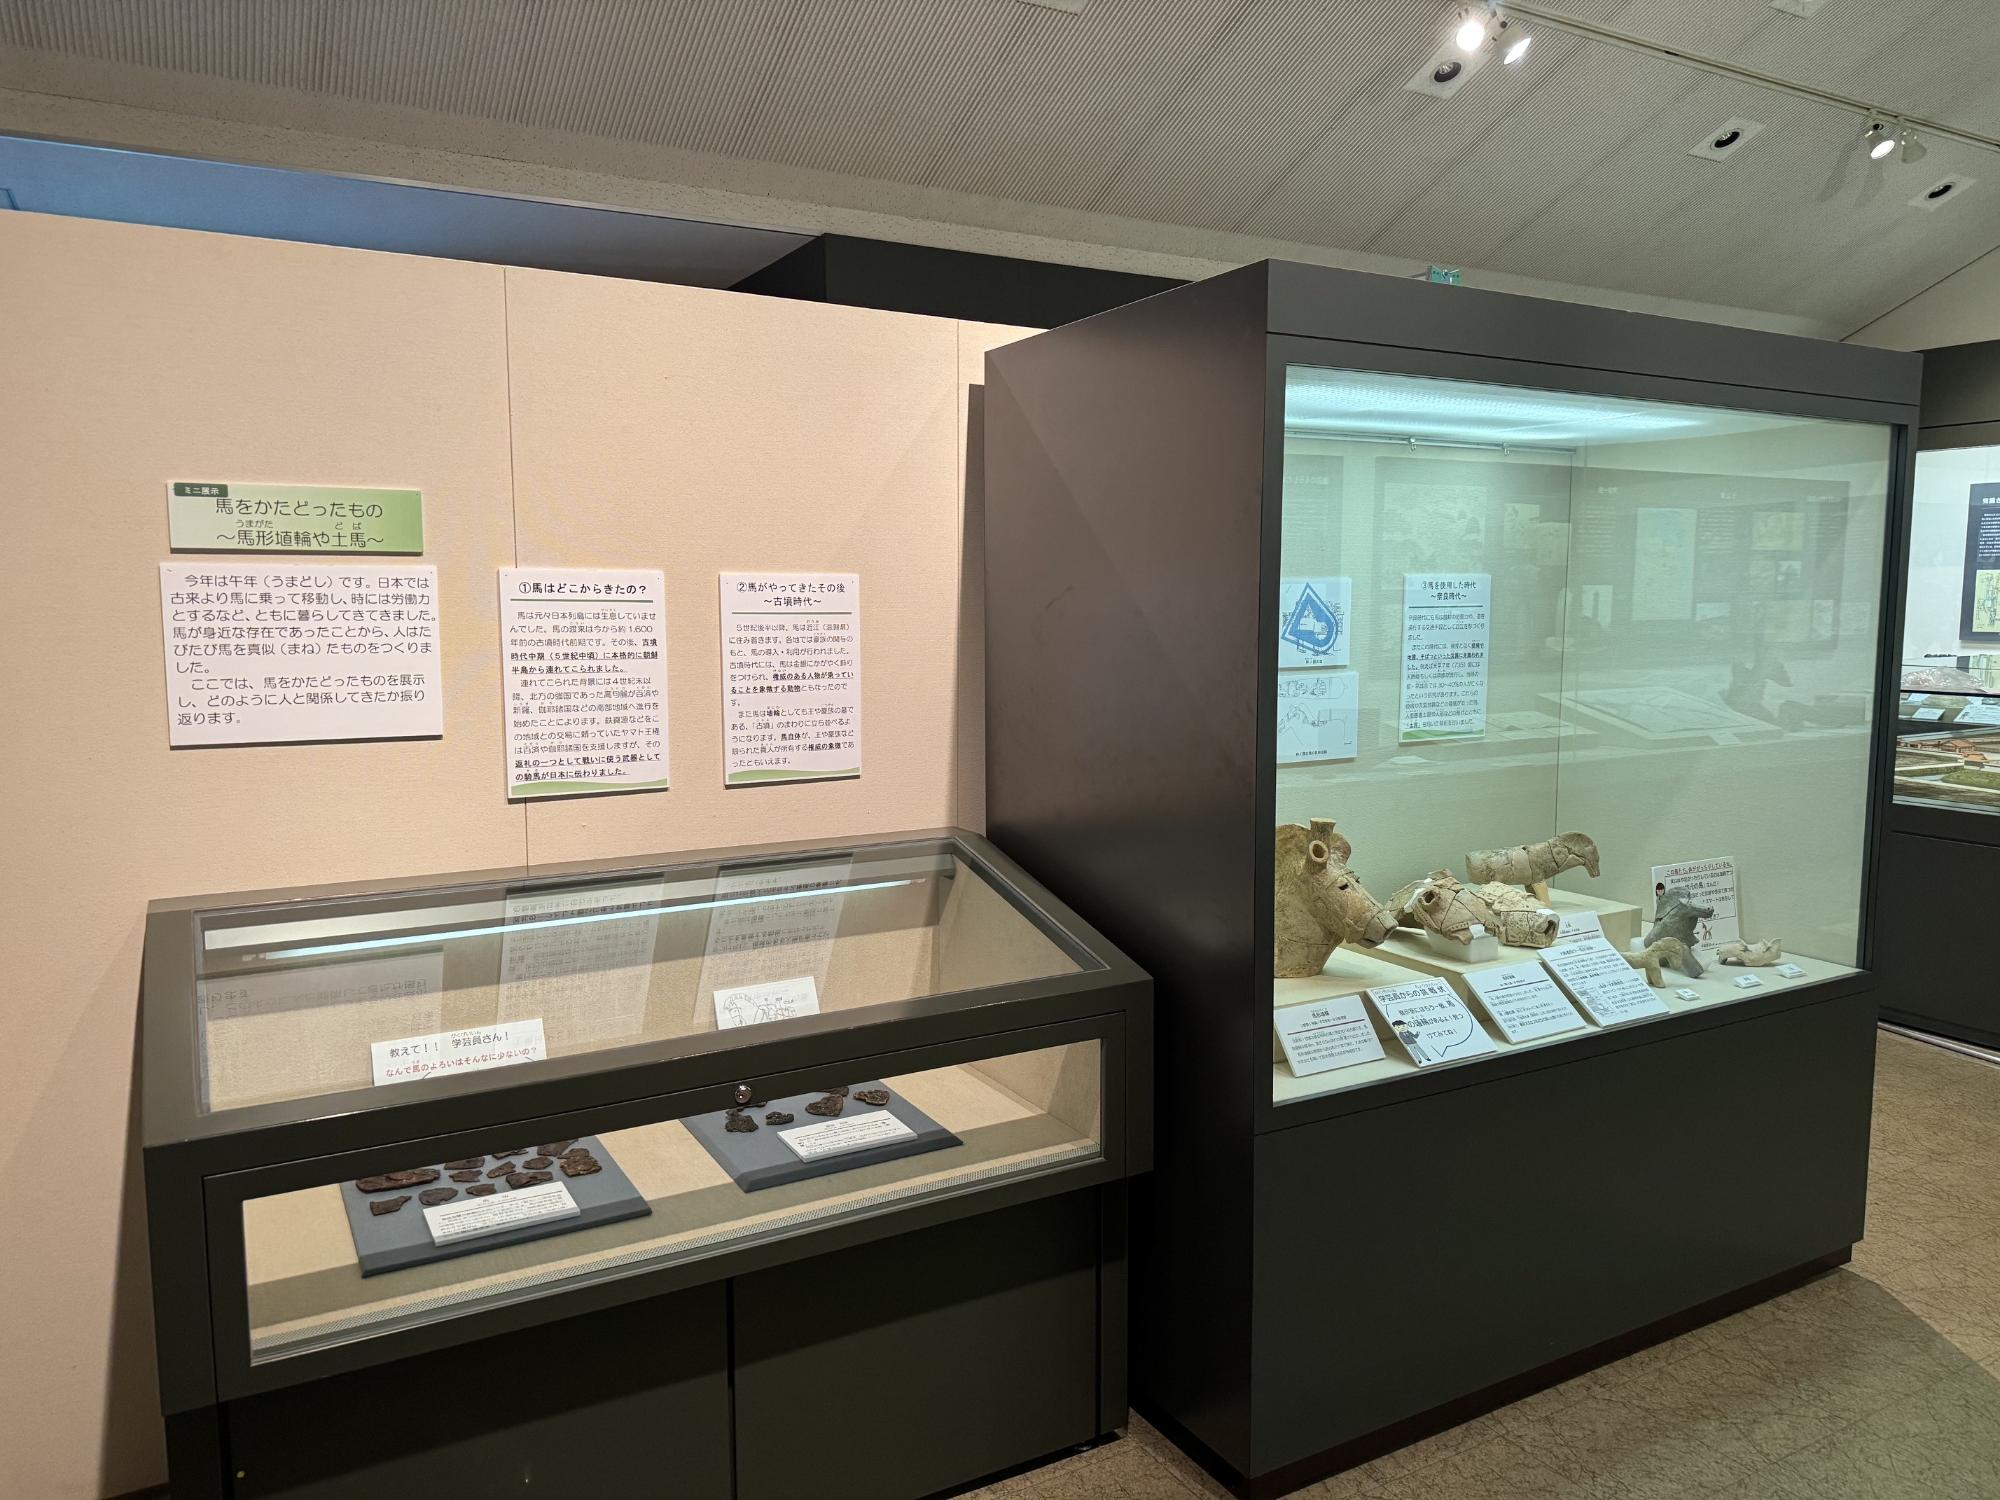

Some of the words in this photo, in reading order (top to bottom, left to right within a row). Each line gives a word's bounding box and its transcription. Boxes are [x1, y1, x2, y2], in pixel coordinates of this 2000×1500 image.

[184, 486, 219, 495] ミニ展示
[215, 498, 383, 518] 馬をかたどったもの
[235, 519, 274, 529] うまがた
[184, 574, 430, 589] 今年は午年（うまどし）です。日本では
[519, 581, 647, 595] ①馬はどこからきたの？
[737, 582, 846, 594] ②馬がやってきたその後
[170, 591, 430, 606] 古来より馬に乗って移動し、時には労働力
[172, 608, 436, 622] とするなど、ともに暮らしてきてきました。
[517, 611, 656, 621] 馬は元々日本列島には生息していませ
[172, 625, 432, 640] 馬が身近な存在であったことから、人はた
[173, 642, 432, 656] びたび馬を真似（まね）たものをつくりま
[510, 638, 658, 648] 年前の古墳時代前期です。その後、古墳
[176, 660, 211, 674] した。
[512, 665, 625, 675] 半島から連れてこられました。
[191, 673, 425, 690] ここでは、馬をかたどったものを展示
[178, 690, 425, 708] し、どのように人と関係してきたか振り
[177, 712, 241, 726] 返ります。
[515, 754, 661, 768] 返礼の一つとして戦いに使う武器として
[386, 1047, 537, 1077] なんで馬のよろいはそんなに少ないの？
